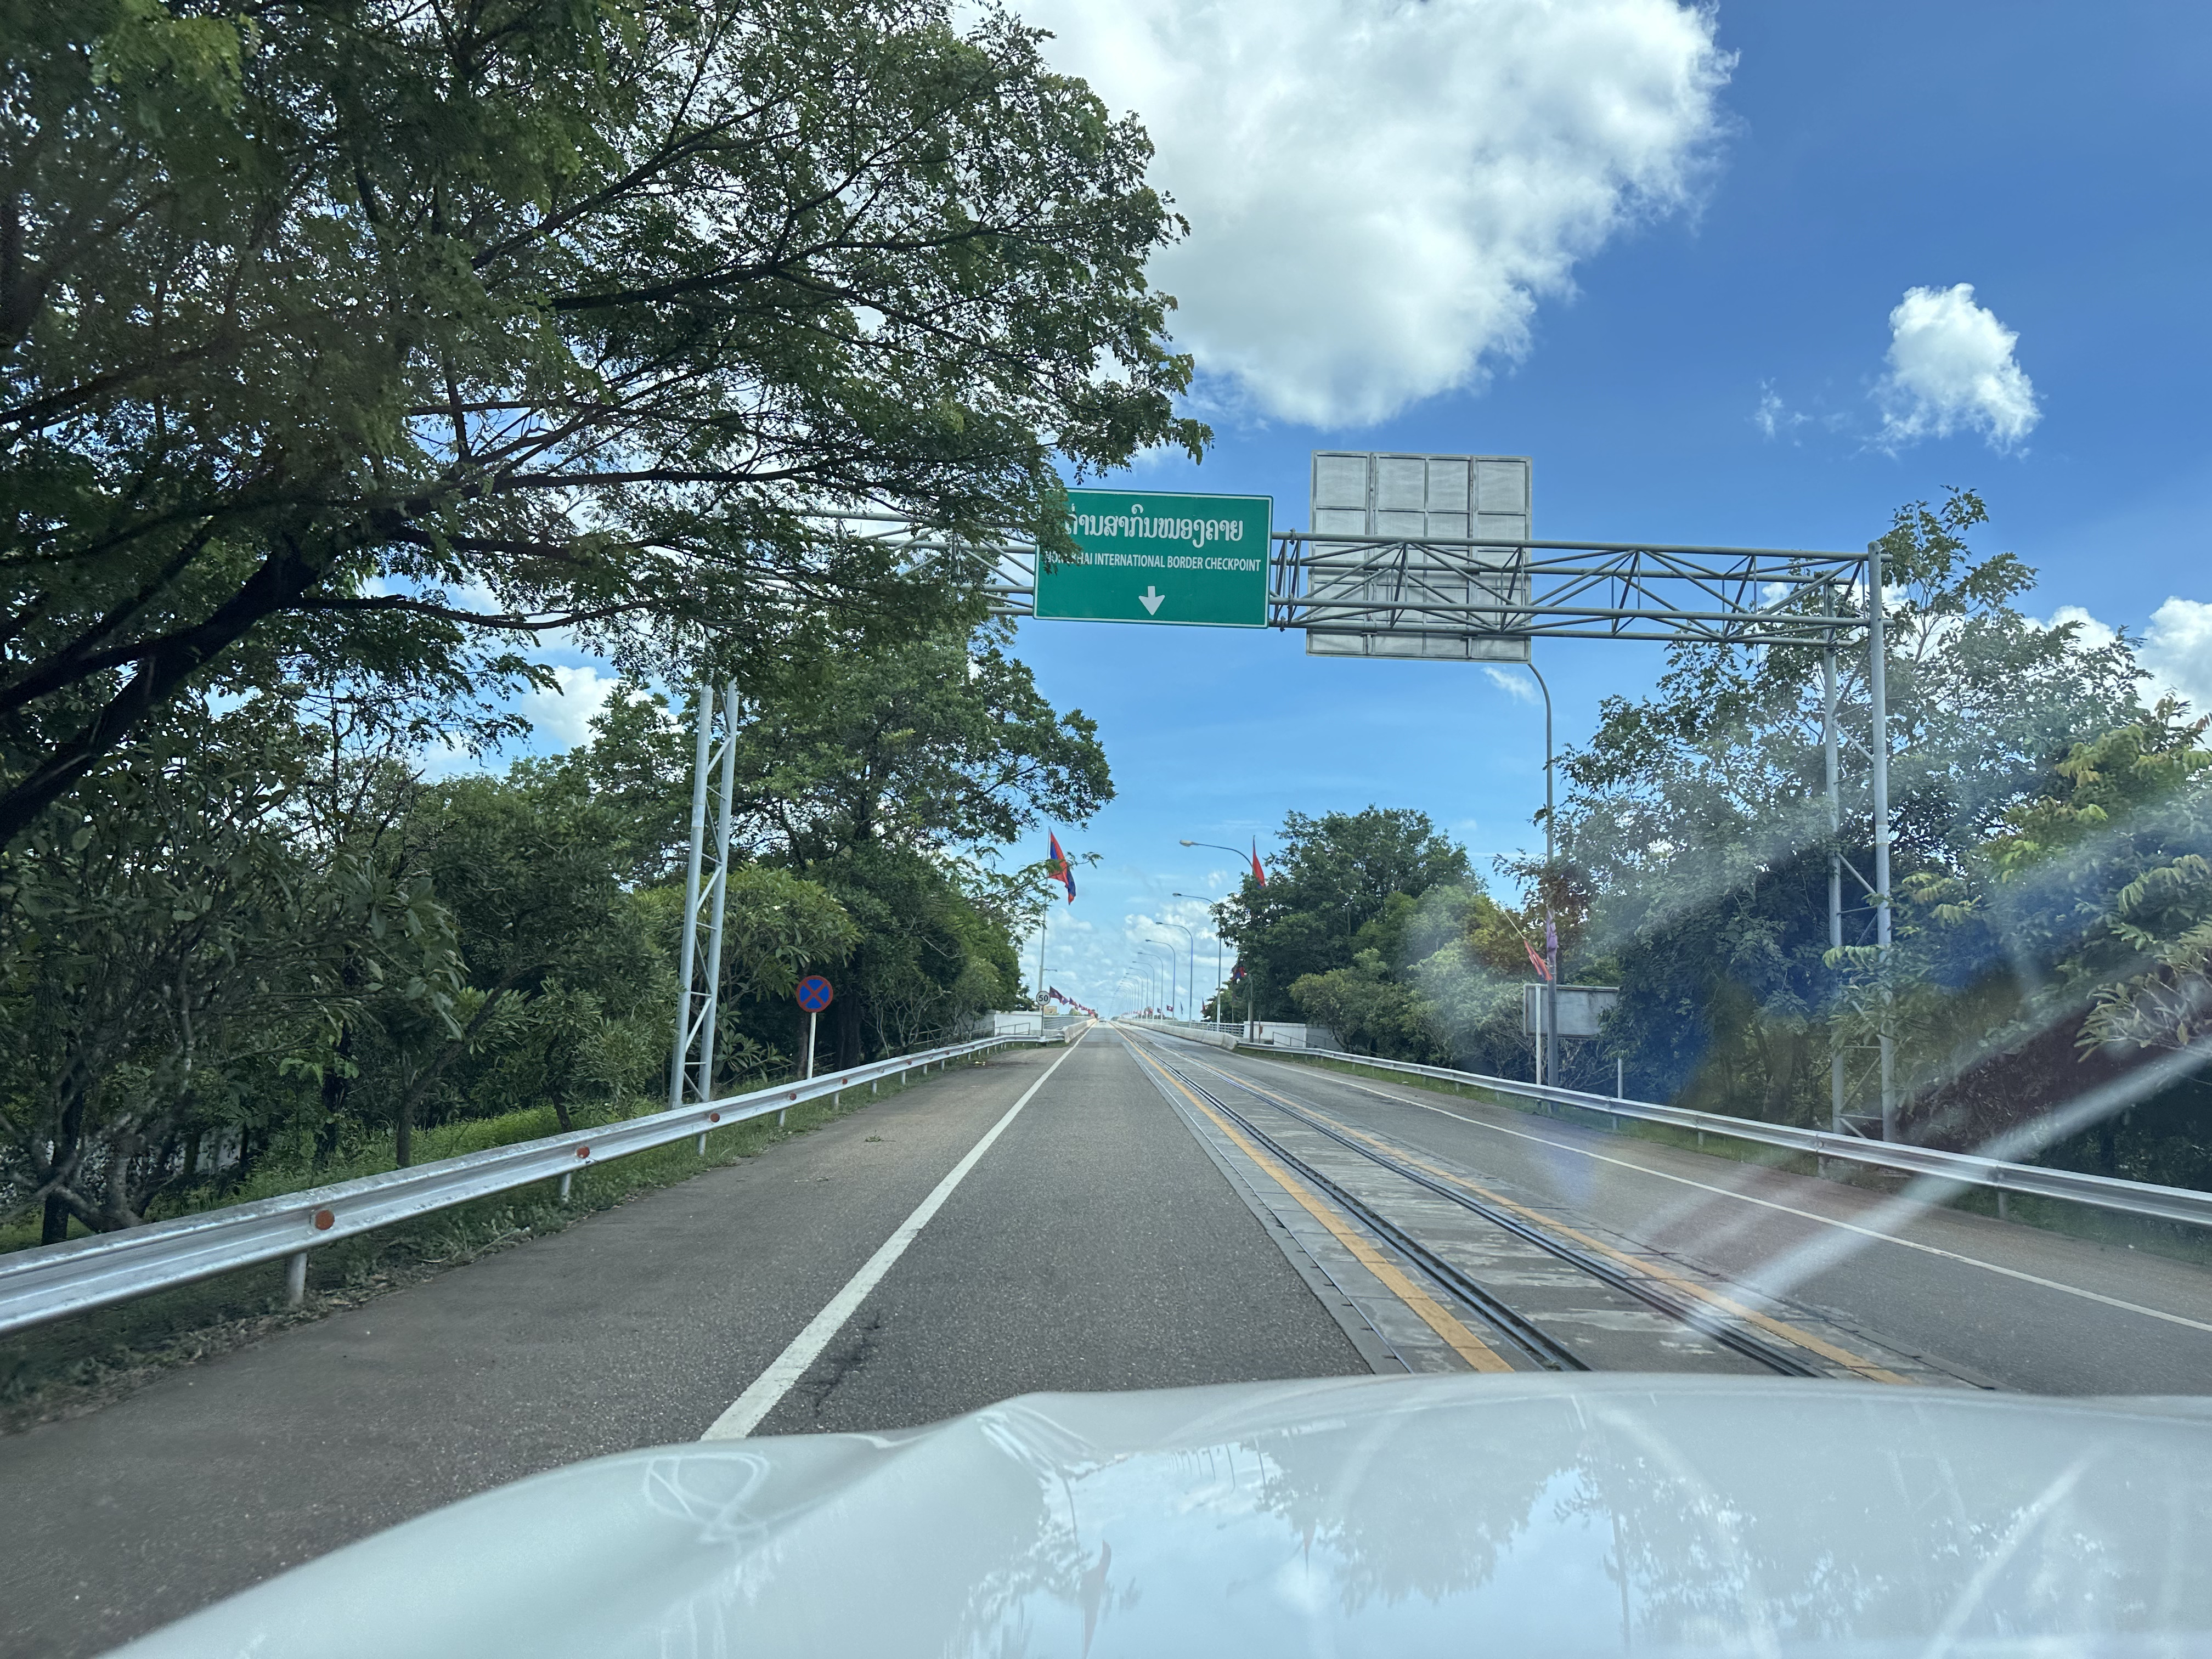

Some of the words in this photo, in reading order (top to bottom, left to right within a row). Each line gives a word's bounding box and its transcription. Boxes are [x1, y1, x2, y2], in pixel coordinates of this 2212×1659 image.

[1045, 551, 1093, 565] NOKHAI
[1094, 553, 1165, 568] INTERNATIONAL
[1167, 556, 1204, 569] BORDER
[1205, 557, 1261, 572] CHECKPOINT
